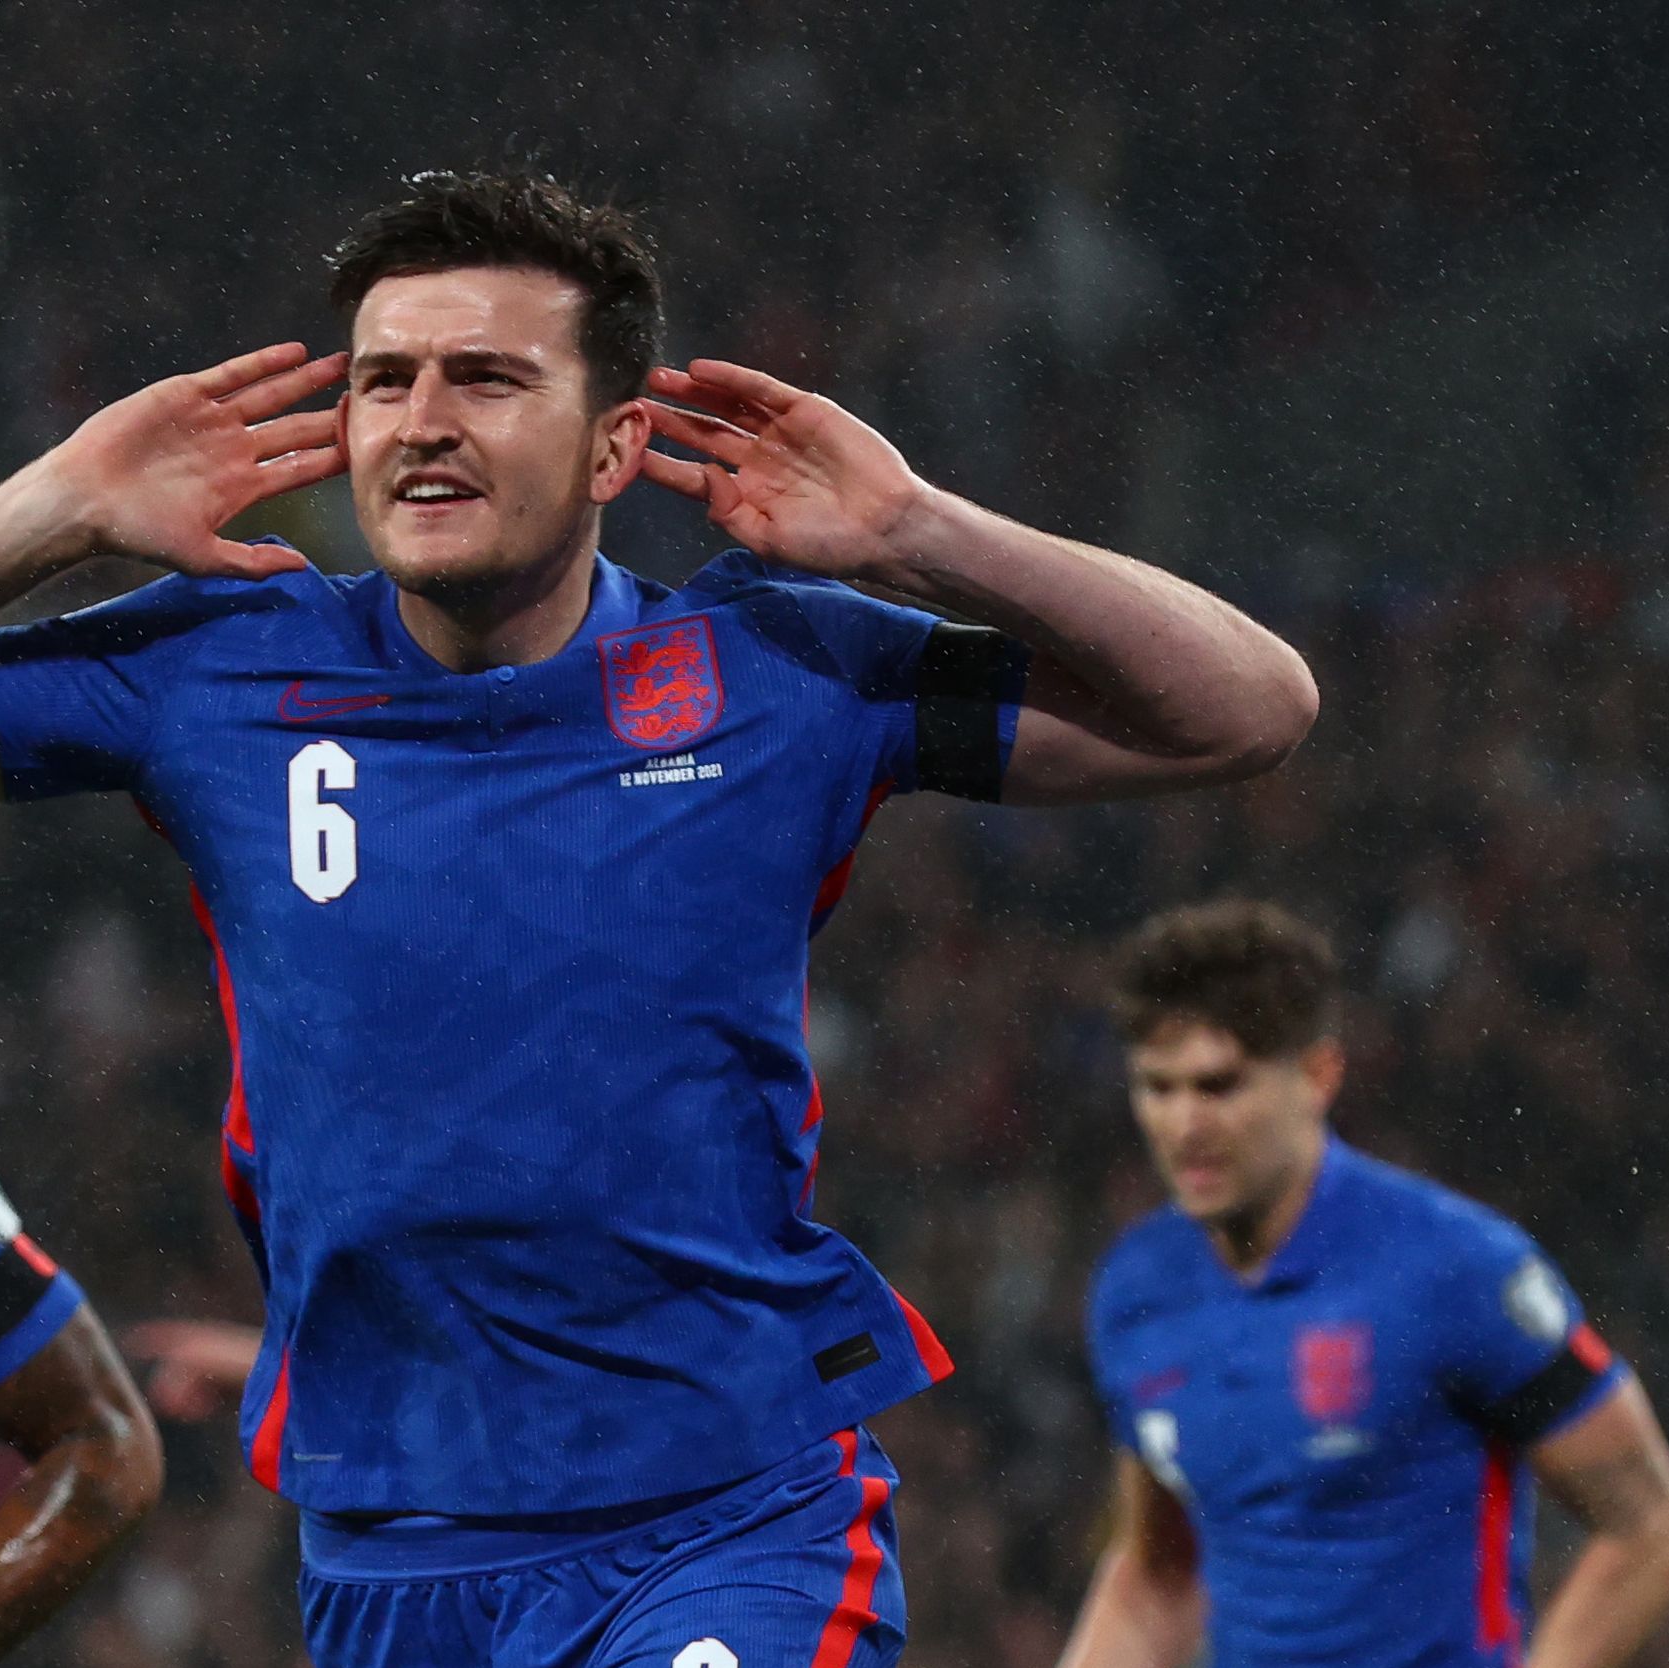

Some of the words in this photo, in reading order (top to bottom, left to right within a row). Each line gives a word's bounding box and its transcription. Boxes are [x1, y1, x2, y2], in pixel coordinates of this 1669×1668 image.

[288, 740, 357, 904] 6
[619, 772, 632, 787] 12
[633, 767, 696, 785] NOVEMBER
[696, 763, 723, 780] 2021
